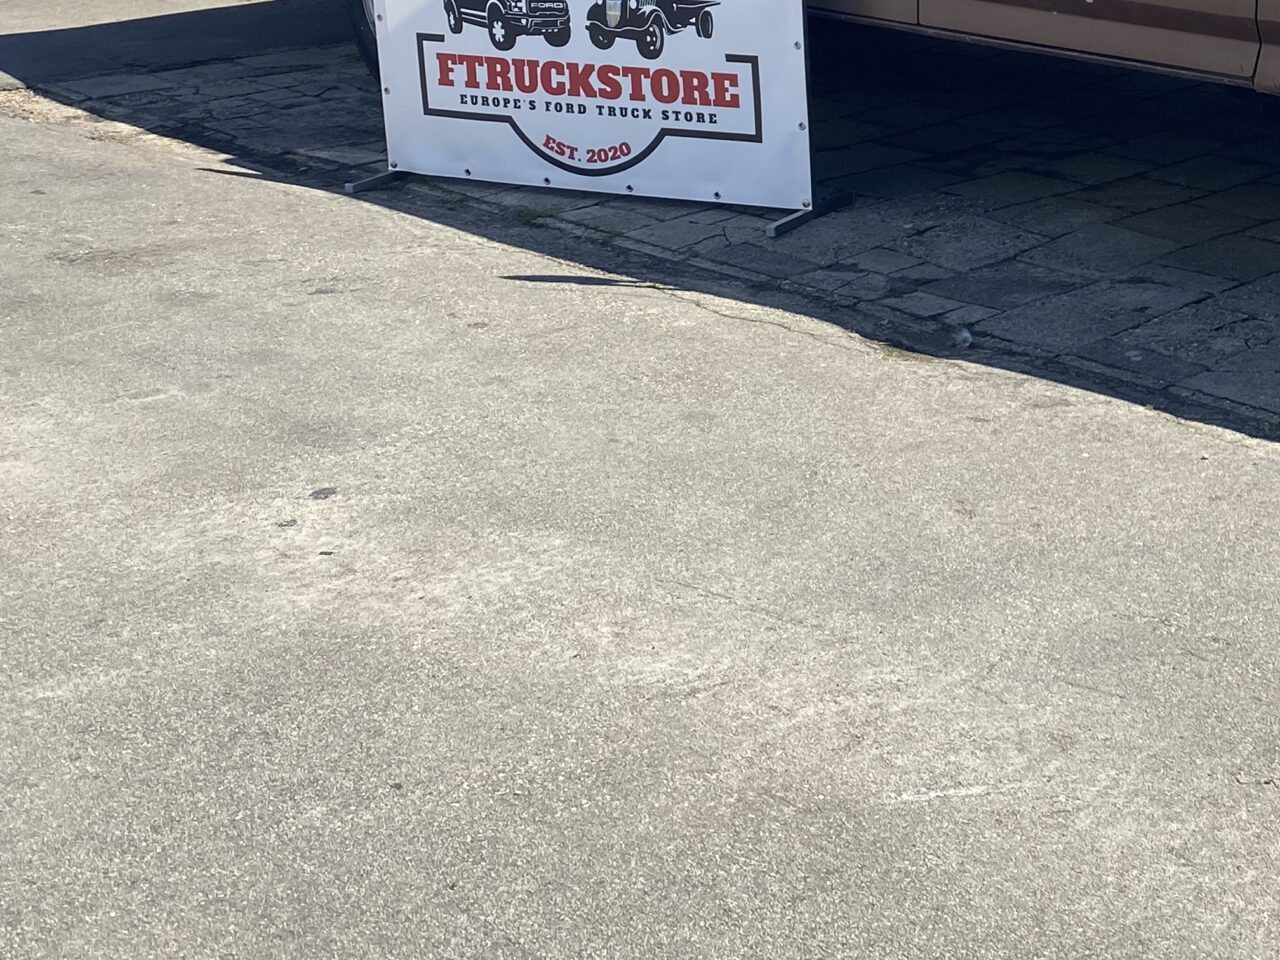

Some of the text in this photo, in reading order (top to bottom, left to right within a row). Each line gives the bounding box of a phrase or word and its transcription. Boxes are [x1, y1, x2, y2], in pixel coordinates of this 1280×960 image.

[435, 52, 740, 109] FTRUCKSTORE
[459, 94, 718, 125] EUROPE'S FORD TRUCK STORE
[543, 134, 632, 164] EST. 2020
